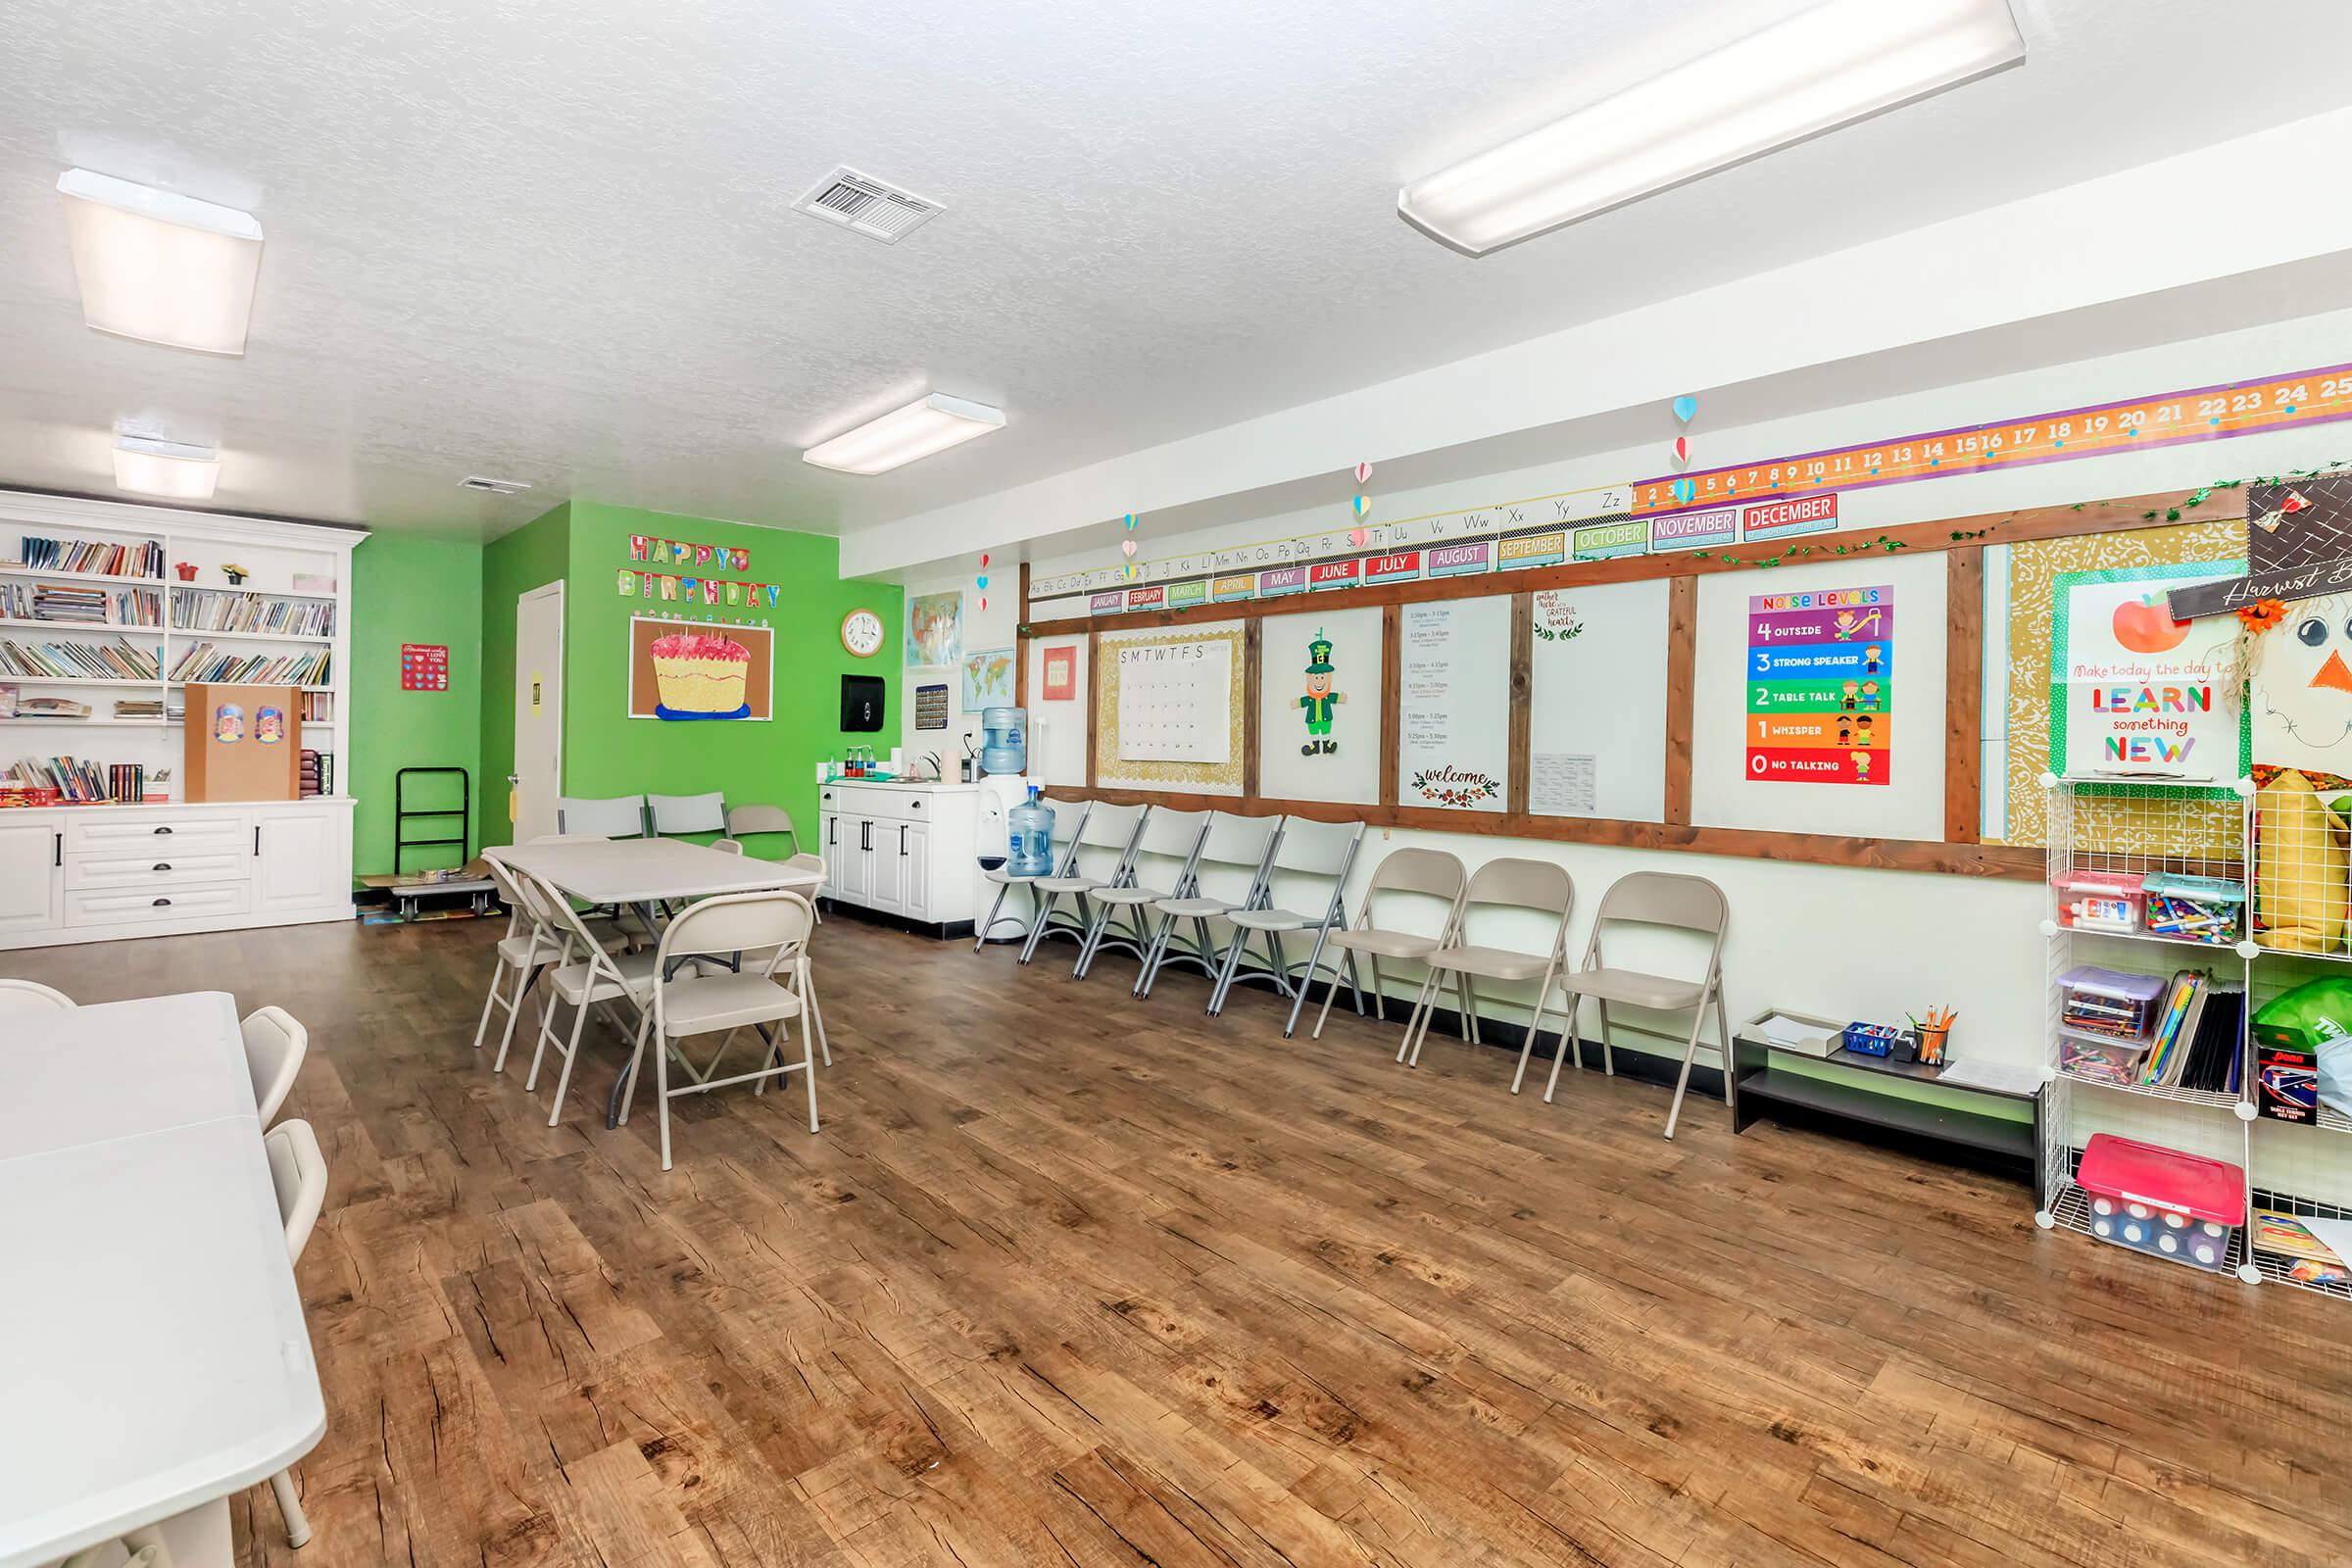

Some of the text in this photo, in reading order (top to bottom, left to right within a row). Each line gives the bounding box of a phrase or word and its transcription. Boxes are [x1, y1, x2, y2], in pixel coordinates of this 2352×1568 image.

[1649, 489, 1657, 499] 2
[1706, 478, 1715, 490] 5
[1727, 474, 1737, 487] 6
[1748, 471, 1758, 484] 7
[1769, 468, 1780, 480] 8
[1787, 466, 1797, 478] 9
[1807, 462, 1826, 476] 10
[1835, 457, 1851, 472] 11
[1863, 453, 1882, 467] 12
[1892, 448, 1911, 464] 13
[1923, 443, 1943, 459] 14
[1956, 437, 1977, 453] 15
[1981, 433, 2002, 449] 16
[2014, 428, 2035, 444] 17
[2048, 422, 2071, 439] 18
[2084, 416, 2109, 433] 19
[2119, 411, 2146, 428] 20
[2157, 405, 2181, 422] 21
[2198, 398, 2227, 416] 22
[2231, 392, 2263, 412] 23
[2275, 385, 2308, 405] 24
[2320, 378, 2352, 398] 25
[1749, 497, 1832, 528] DECEMBER
[1216, 555, 1230, 567] Mm
[1236, 552, 1249, 564] Nn
[1255, 549, 1270, 561] Oo
[1278, 545, 1291, 560] Pp
[1297, 542, 1310, 557] Qq
[1322, 538, 1332, 550] Rr
[1396, 528, 1407, 541] Uu
[1431, 521, 1444, 534] Vv
[1463, 515, 1489, 529] Ww
[1509, 510, 1524, 523] Xx
[1554, 501, 1570, 518] Yy
[1602, 492, 1621, 509] Zz
[1656, 514, 1733, 537] NOVEMBER
[1580, 526, 1642, 547] OCTOBER
[630, 535, 730, 570] HAPPY
[1437, 548, 1480, 564] AUGUST
[1501, 538, 1561, 557] SEPTEMBER
[1319, 565, 1348, 579] JUNE
[1376, 556, 1408, 572] JULY
[1220, 579, 1247, 591] APRIL
[1271, 571, 1295, 585] MAY
[2223, 567, 2326, 606] Harvest
[618, 570, 780, 609] BIRTHDAY
[1130, 589, 1161, 604] FEBRUARY
[1171, 585, 1202, 597] MARCH
[1093, 595, 1119, 609] JANUARY
[1757, 623, 1822, 641] 4 OUTSIDE
[1120, 651, 1127, 663] S
[1131, 651, 1140, 662] M
[1145, 649, 1152, 661] T
[1154, 649, 1166, 661] W
[1170, 647, 1177, 660] T
[1182, 646, 1190, 659] F
[1196, 645, 1203, 658] S
[1756, 653, 1859, 671] 3 STRONG SPEAKER
[2074, 659, 2232, 684] Make today the day to
[1756, 688, 1836, 706] 2 TABLE TALK
[2093, 686, 2211, 713] LEARN
[1758, 721, 1822, 738] 1 WHISPER
[2113, 718, 2188, 737] something
[2105, 736, 2195, 763] NEW
[1752, 755, 1839, 774] 0 NO TALKING
[1425, 764, 1488, 785] welcome
